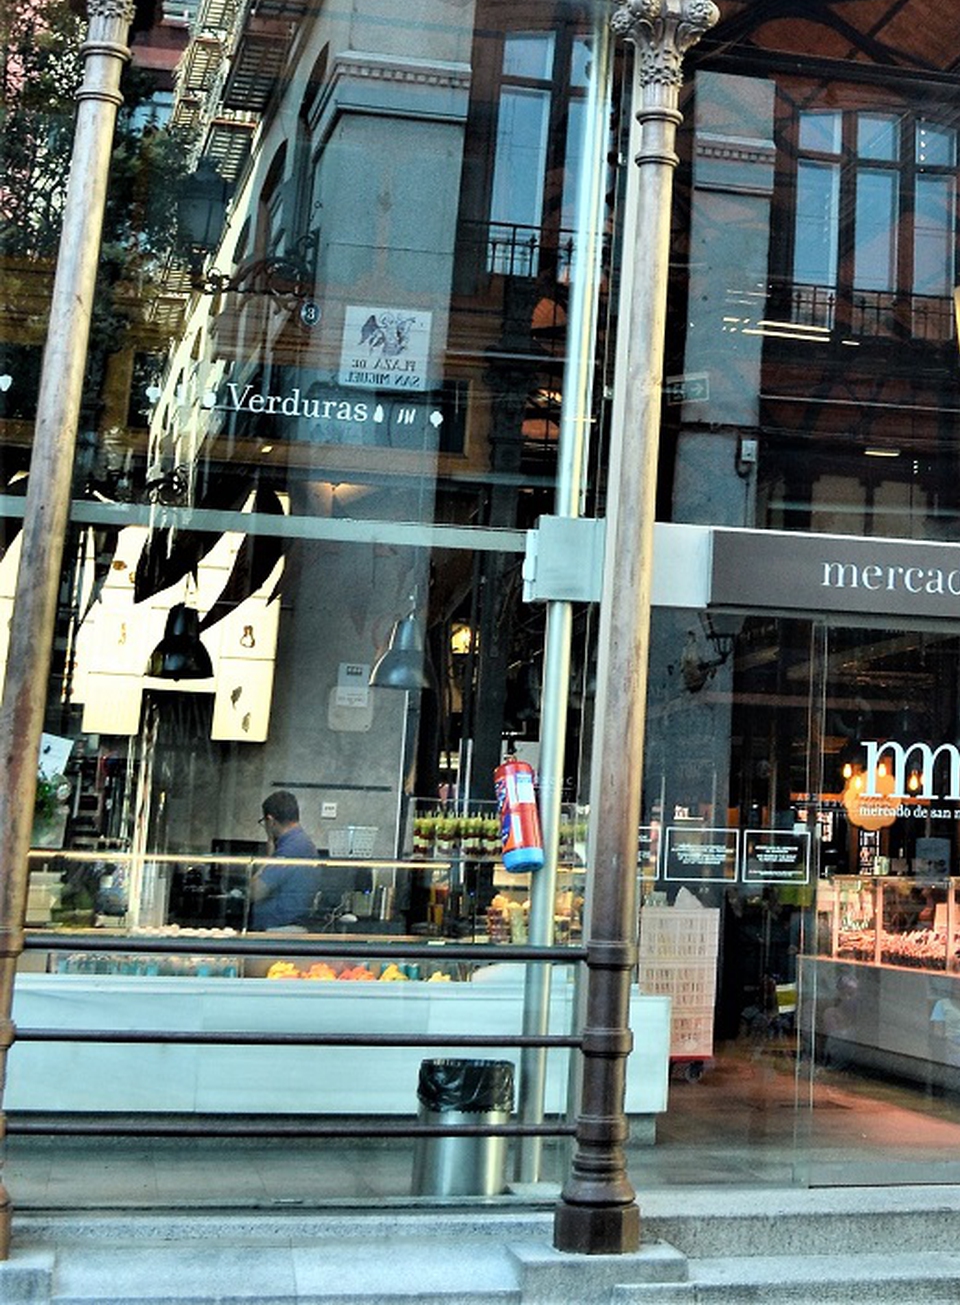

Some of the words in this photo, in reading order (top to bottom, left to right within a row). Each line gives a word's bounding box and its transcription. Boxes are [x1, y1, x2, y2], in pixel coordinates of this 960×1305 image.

[227, 382, 368, 421] Verduras
[859, 805, 911, 818] mercado
[913, 805, 928, 818] de
[930, 809, 951, 819] san
